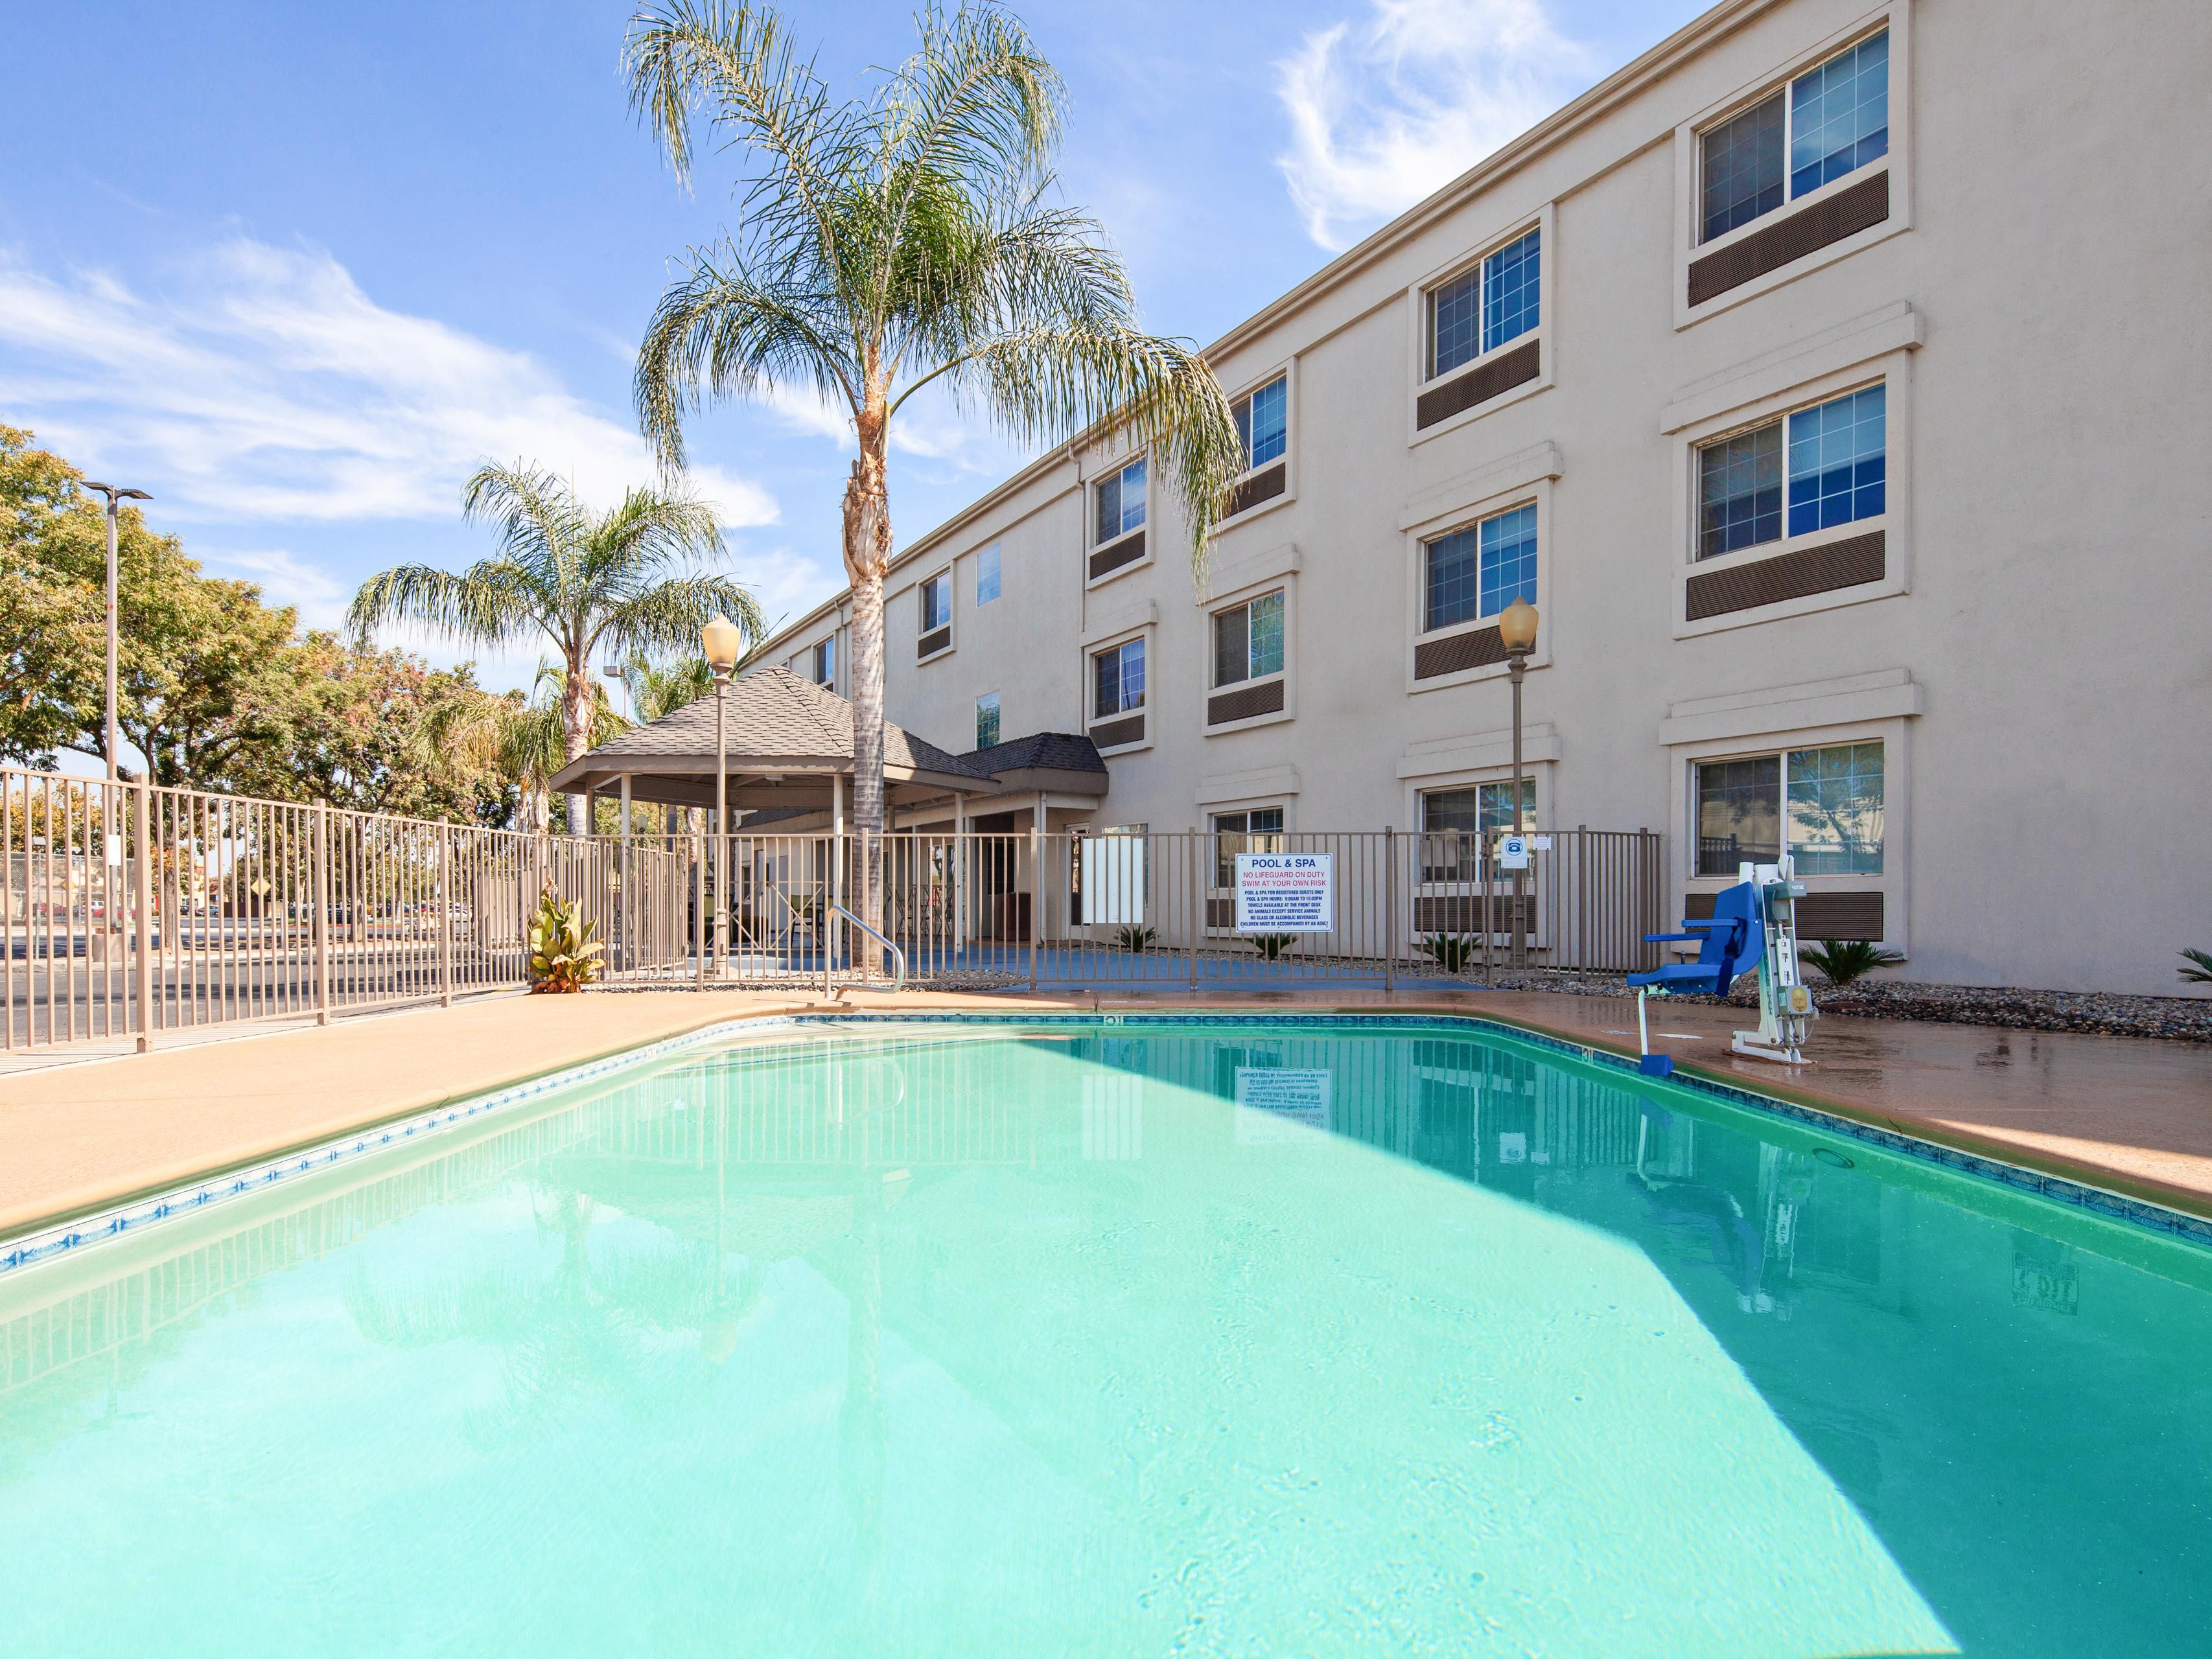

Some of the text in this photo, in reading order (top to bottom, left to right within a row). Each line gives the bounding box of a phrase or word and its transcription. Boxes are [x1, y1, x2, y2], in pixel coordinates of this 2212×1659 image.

[1252, 859, 1315, 868] POOL & SPA
